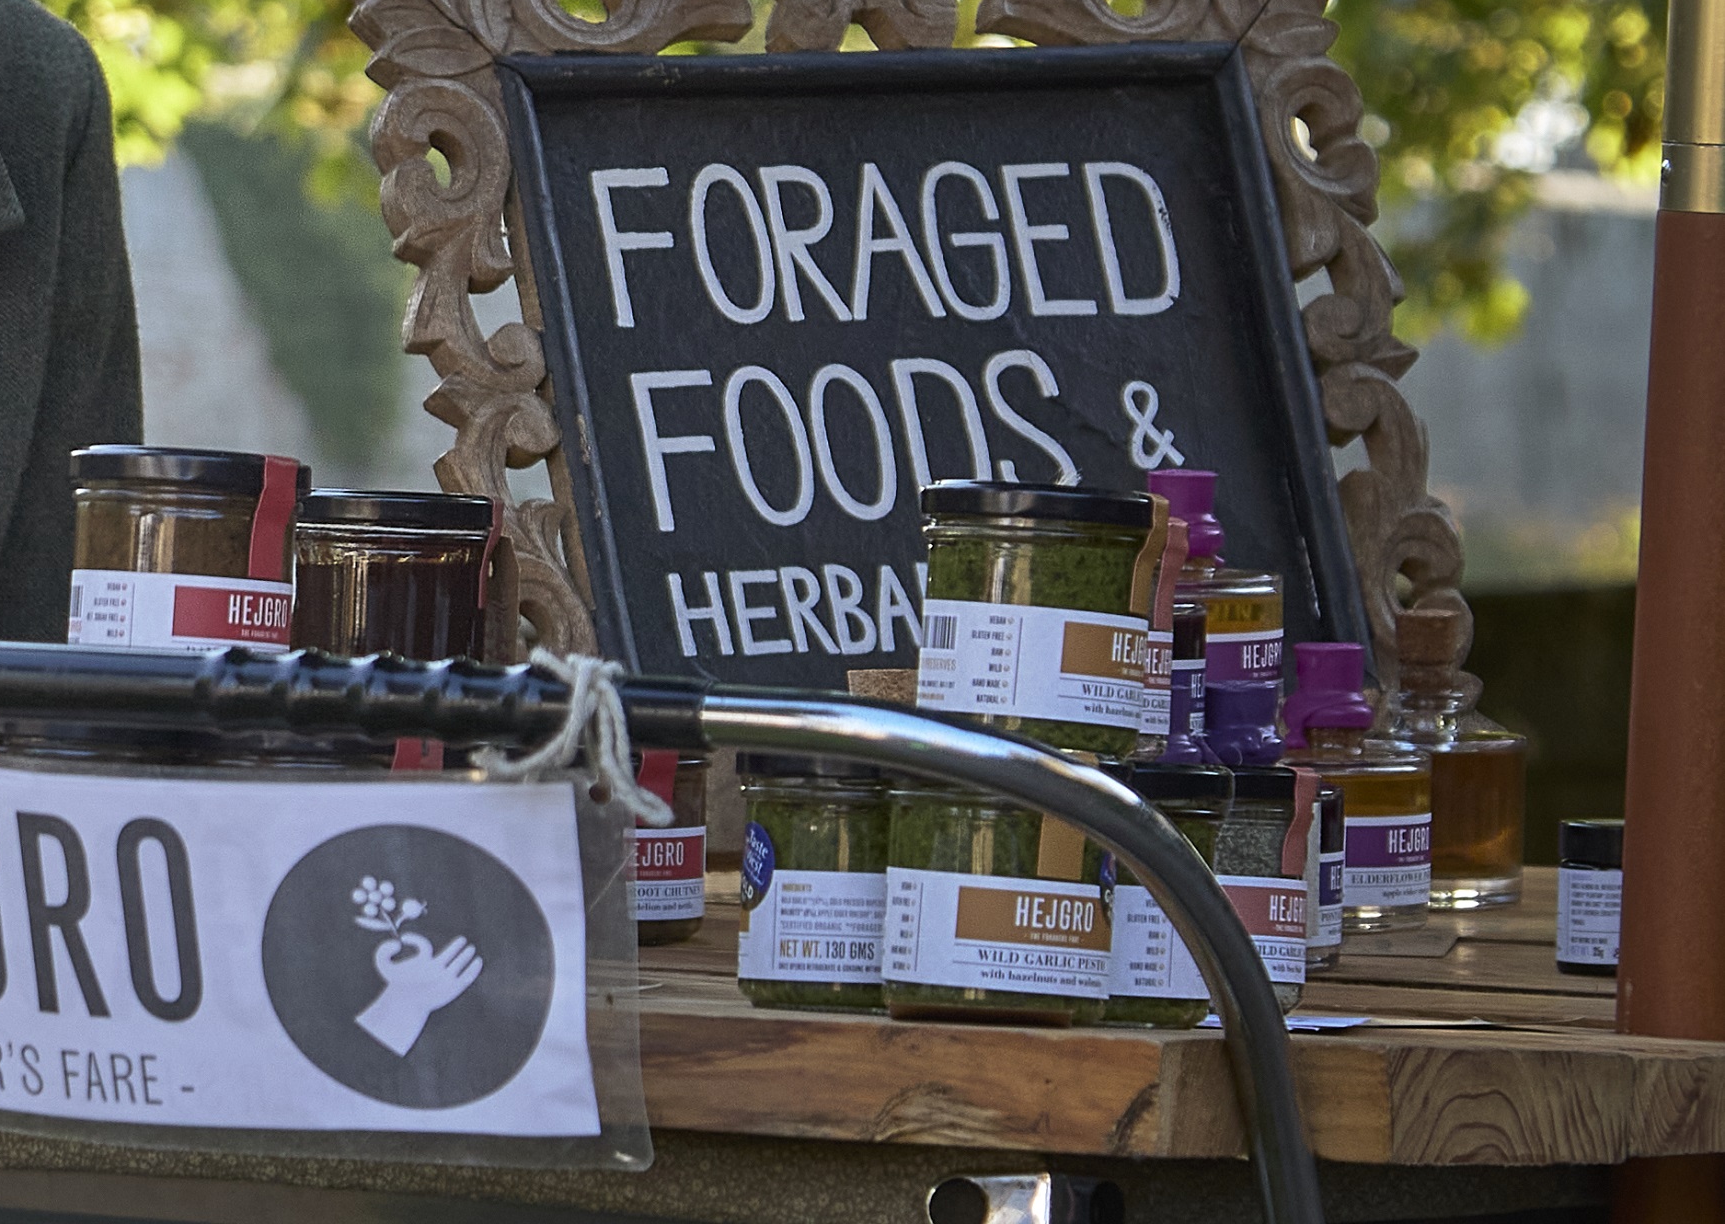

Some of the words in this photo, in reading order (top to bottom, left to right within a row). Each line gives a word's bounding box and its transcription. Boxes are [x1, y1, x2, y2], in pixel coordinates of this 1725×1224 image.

[591, 162, 1180, 328] FORAGED
[630, 349, 1082, 532] FOODS
[1120, 380, 1185, 470] &
[228, 593, 288, 628] HEJGRO
[1082, 683, 1115, 698] WILD
[1084, 701, 1104, 713] with
[633, 841, 685, 867] EJGRO
[636, 887, 662, 897] OOT
[1014, 895, 1095, 932] HEJGRO
[779, 939, 799, 958] NET
[802, 940, 822, 959] WT.
[826, 941, 846, 959] 130
[850, 942, 875, 961] GMS
[978, 948, 1020, 964] WILD
[1025, 950, 1076, 970] GARLIC
[981, 969, 1005, 980] with
[1008, 969, 1058, 984] hazelnuts
[1060, 973, 1076, 986] and
[61, 1049, 163, 1107] FARE
